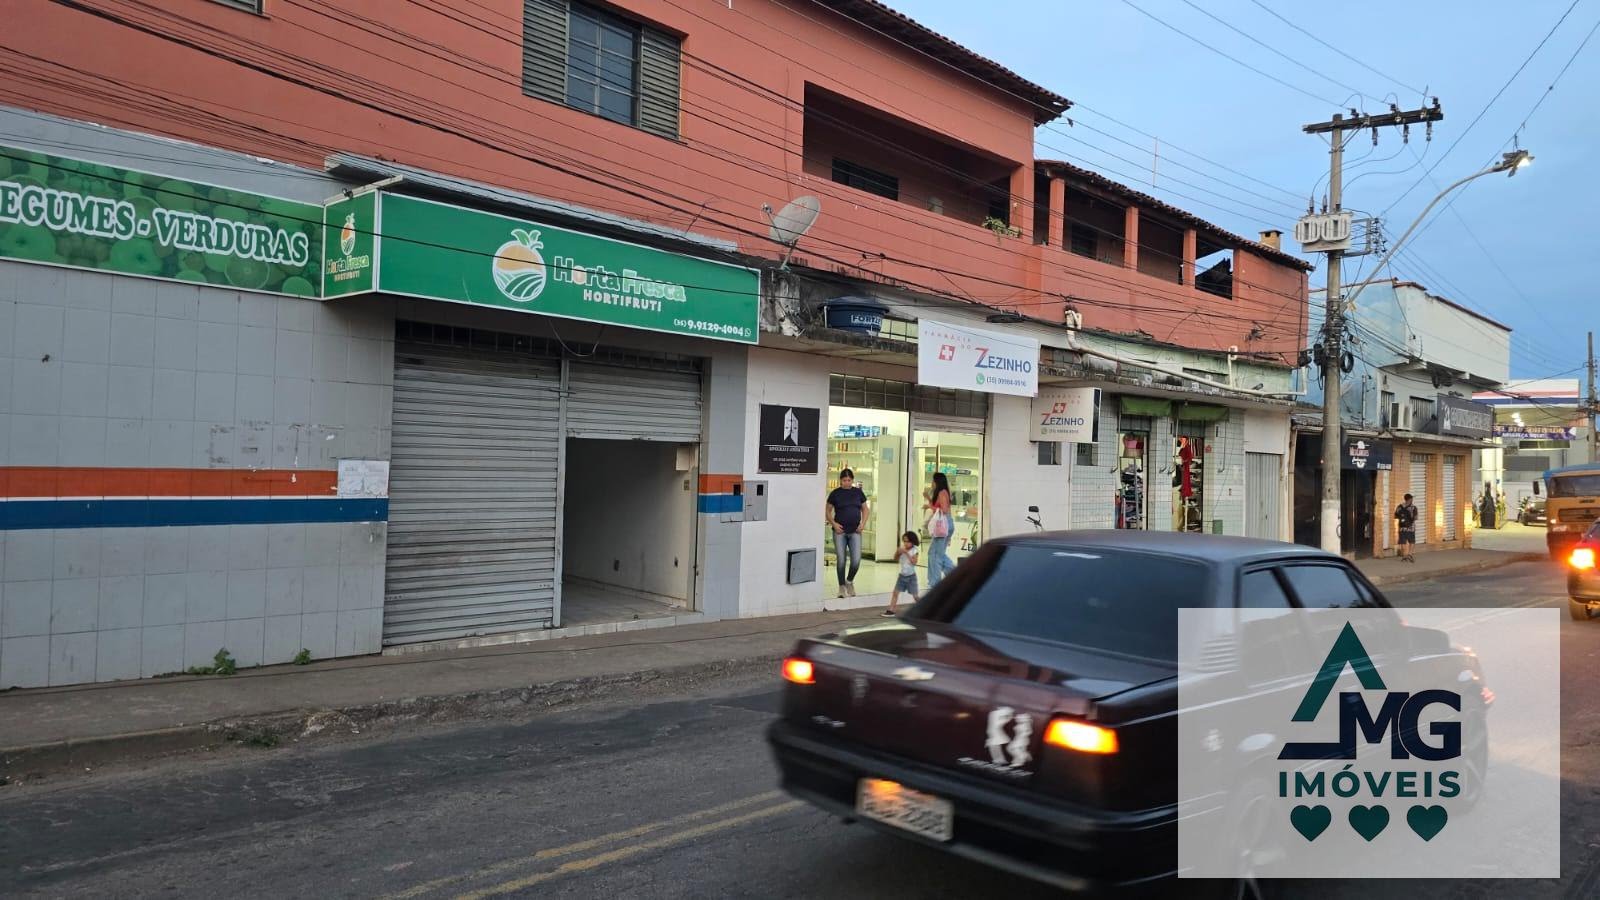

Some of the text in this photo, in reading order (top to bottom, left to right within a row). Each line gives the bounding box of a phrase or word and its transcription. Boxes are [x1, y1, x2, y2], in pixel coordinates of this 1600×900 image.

[153, 209, 309, 267] VERDURAS
[554, 256, 687, 302] Horta Fresca
[583, 289, 661, 312] HORTIFRUTI
[974, 347, 1031, 374] ZEZINHO
[1040, 412, 1084, 426] ZEZINHO
